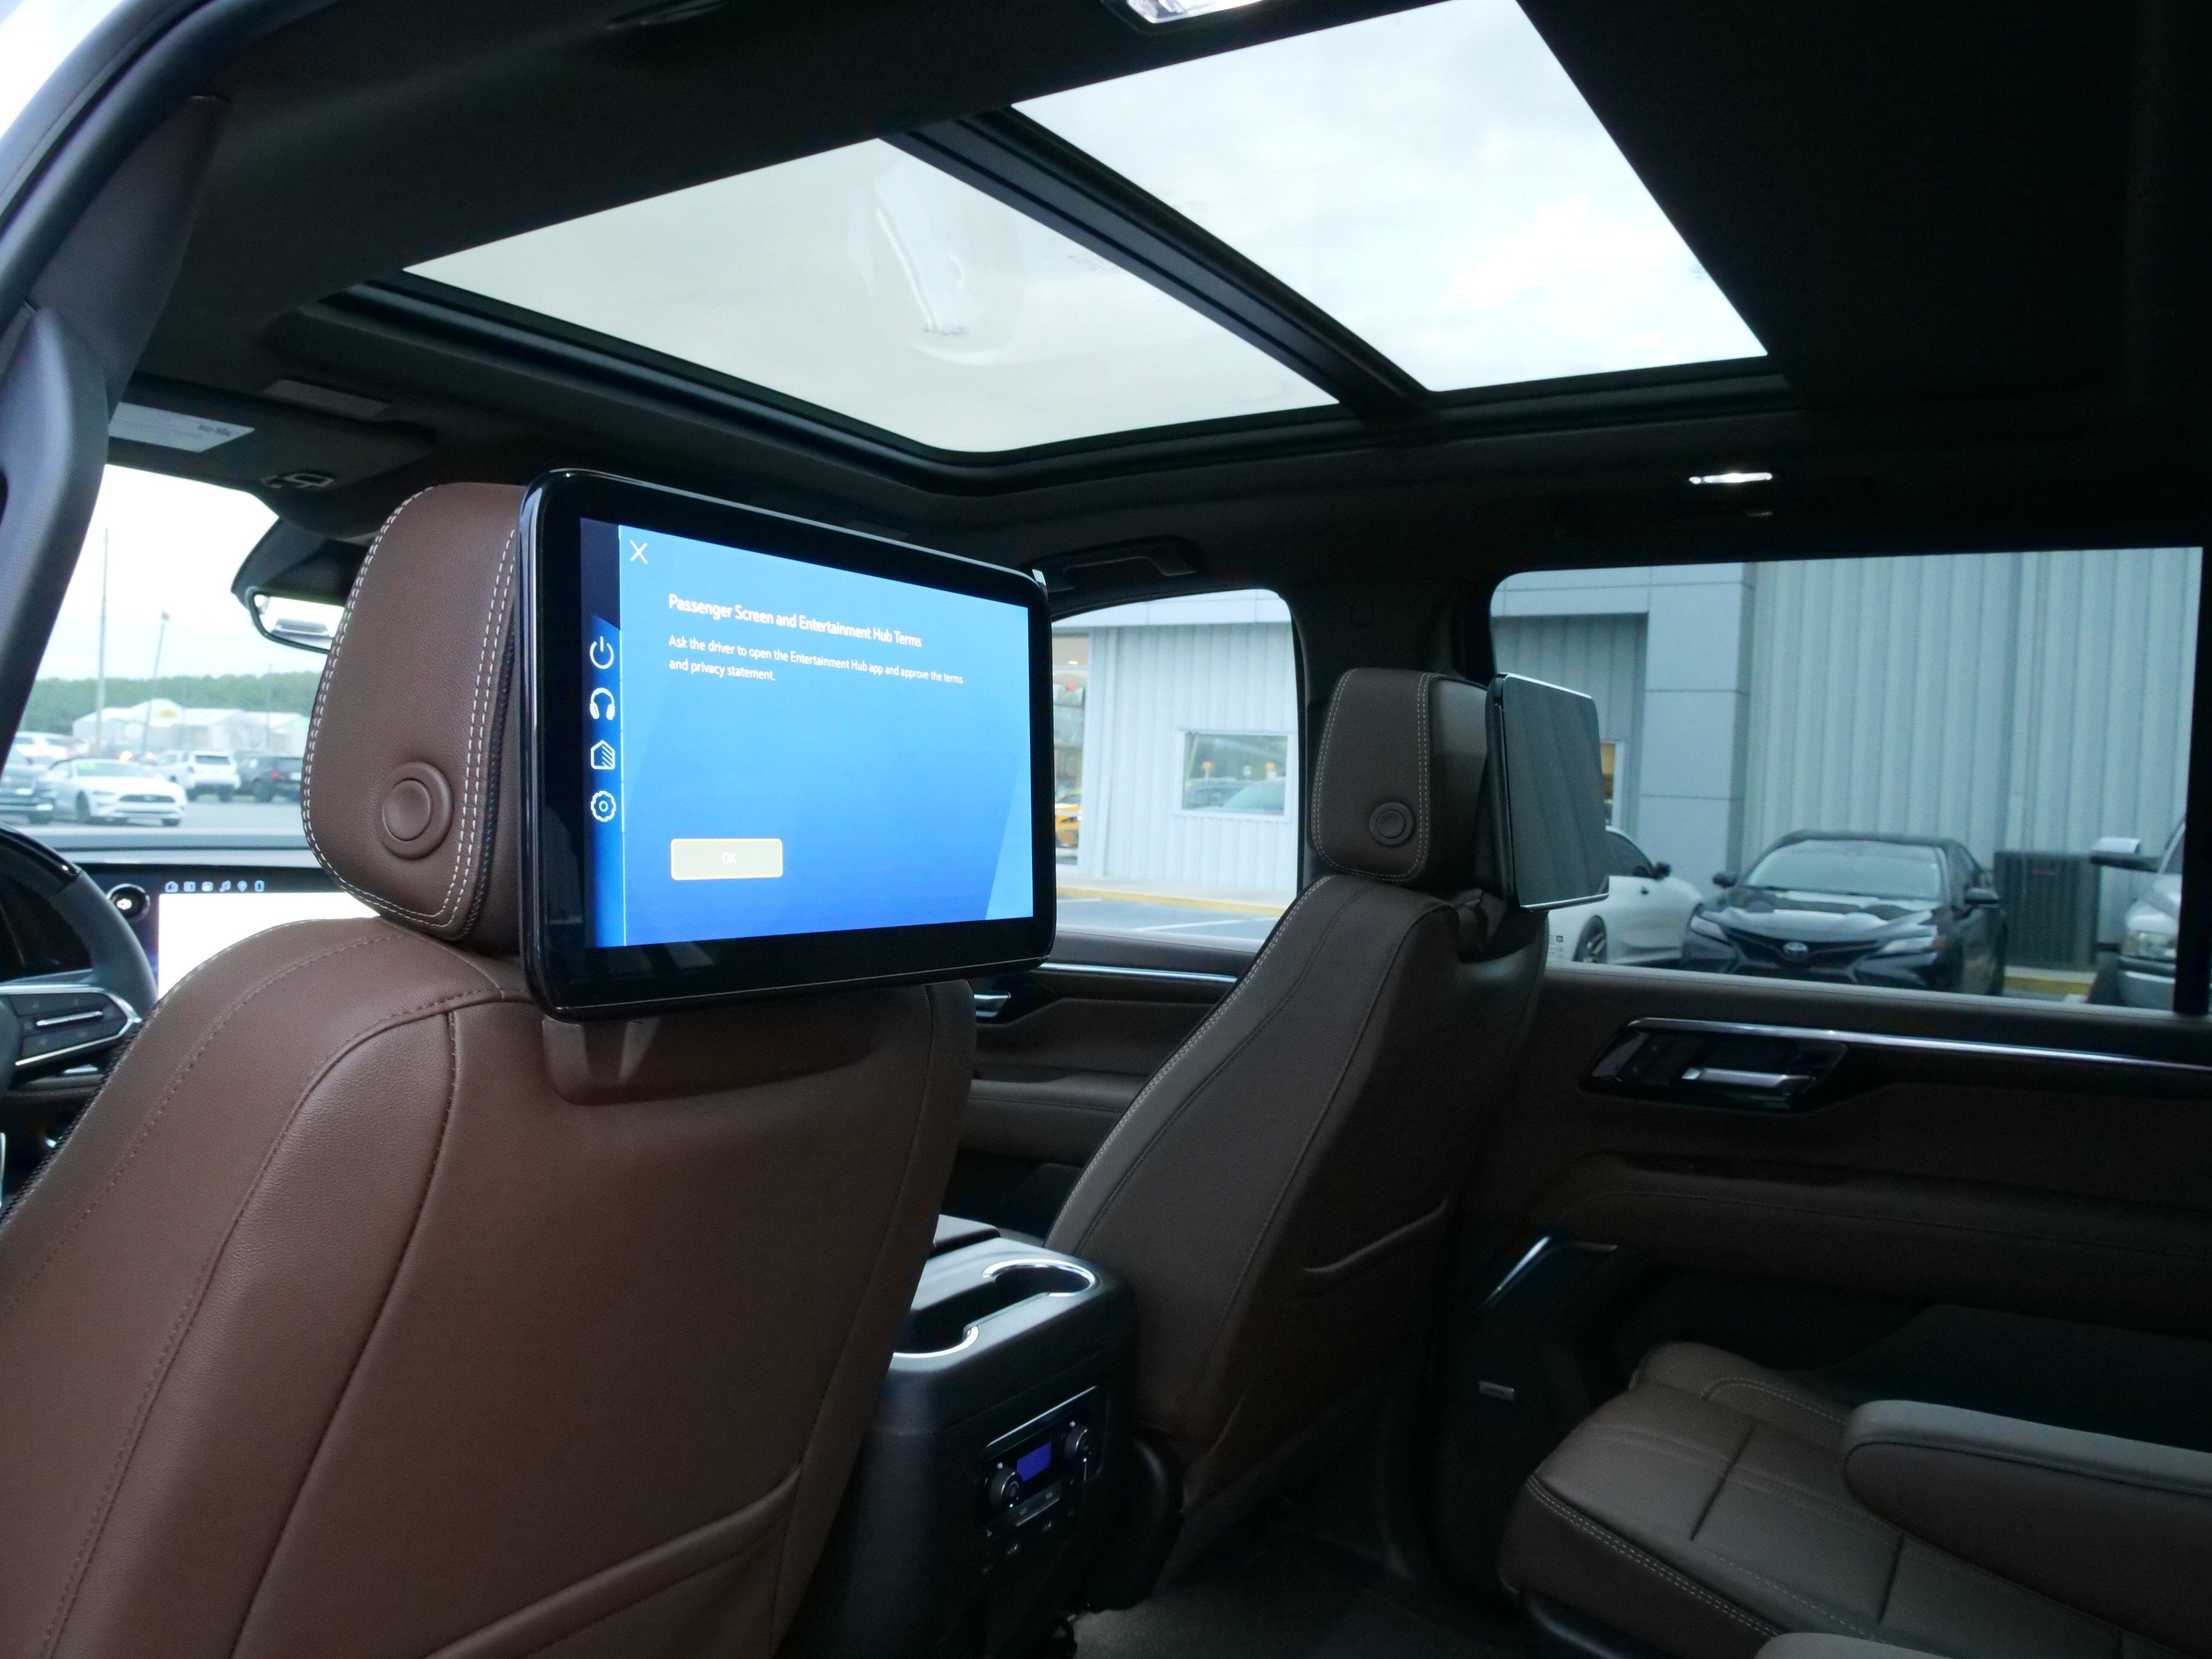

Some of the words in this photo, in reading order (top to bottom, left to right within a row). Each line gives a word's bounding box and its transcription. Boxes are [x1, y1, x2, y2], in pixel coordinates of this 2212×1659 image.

[669, 594, 733, 620] Passenger
[735, 604, 774, 624] Screen
[776, 613, 797, 627] and
[799, 615, 871, 639] Entertainment
[872, 627, 892, 643] Hub
[893, 630, 922, 648] Terms
[669, 635, 687, 648] Ask
[689, 638, 706, 651] the
[708, 640, 735, 654] driver
[737, 645, 747, 656] to
[748, 648, 772, 661] open
[773, 649, 788, 661] the
[790, 651, 850, 669] Entertainment
[851, 660, 868, 672] Hub
[869, 664, 884, 676] app
[885, 665, 899, 676] and
[900, 668, 929, 681] approve
[931, 670, 943, 681] the
[944, 673, 964, 684] terms
[669, 658, 689, 670] and
[691, 662, 725, 678] privacy
[727, 666, 775, 681] statement.
[722, 852, 737, 865] OK
